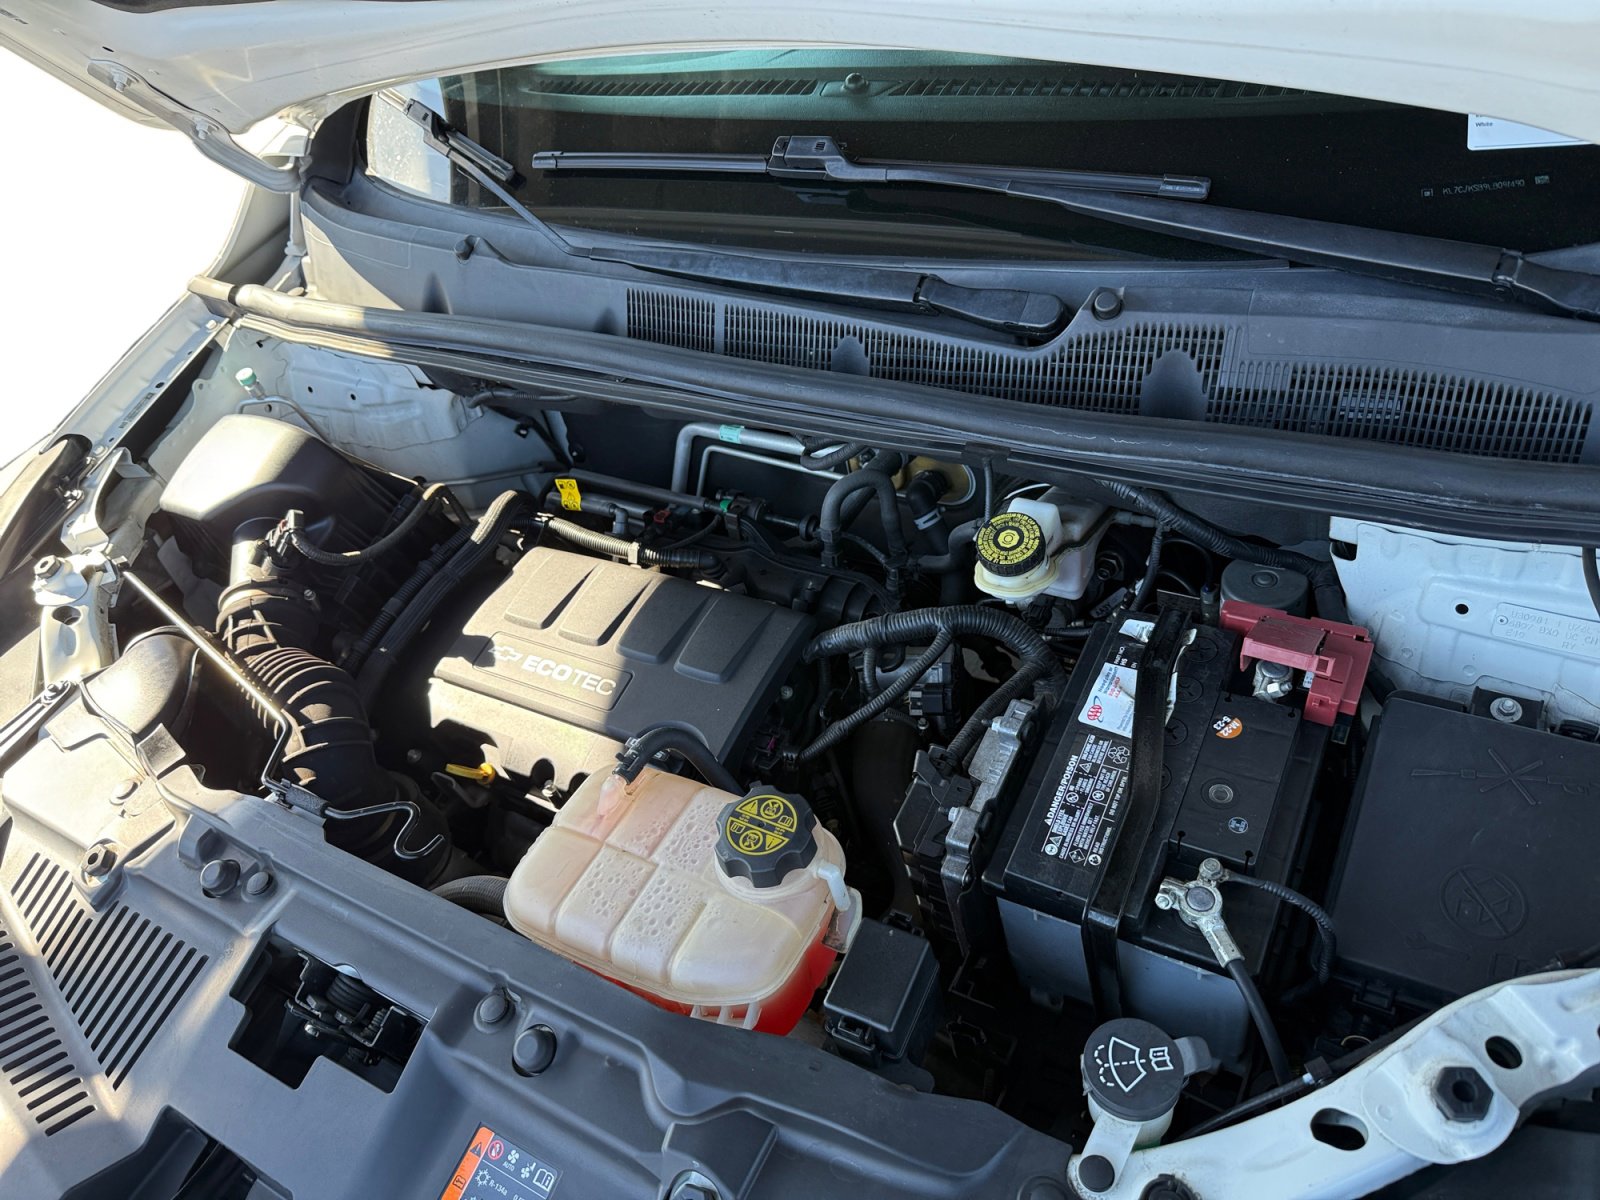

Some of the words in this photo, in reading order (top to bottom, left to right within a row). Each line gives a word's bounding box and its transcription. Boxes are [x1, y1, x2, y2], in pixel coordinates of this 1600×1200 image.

[522, 655, 616, 695] ECOTEC
[1047, 755, 1078, 818] DANGER/POISON
[502, 1161, 516, 1172] AUTO
[488, 1180, 508, 1196] R-134a
